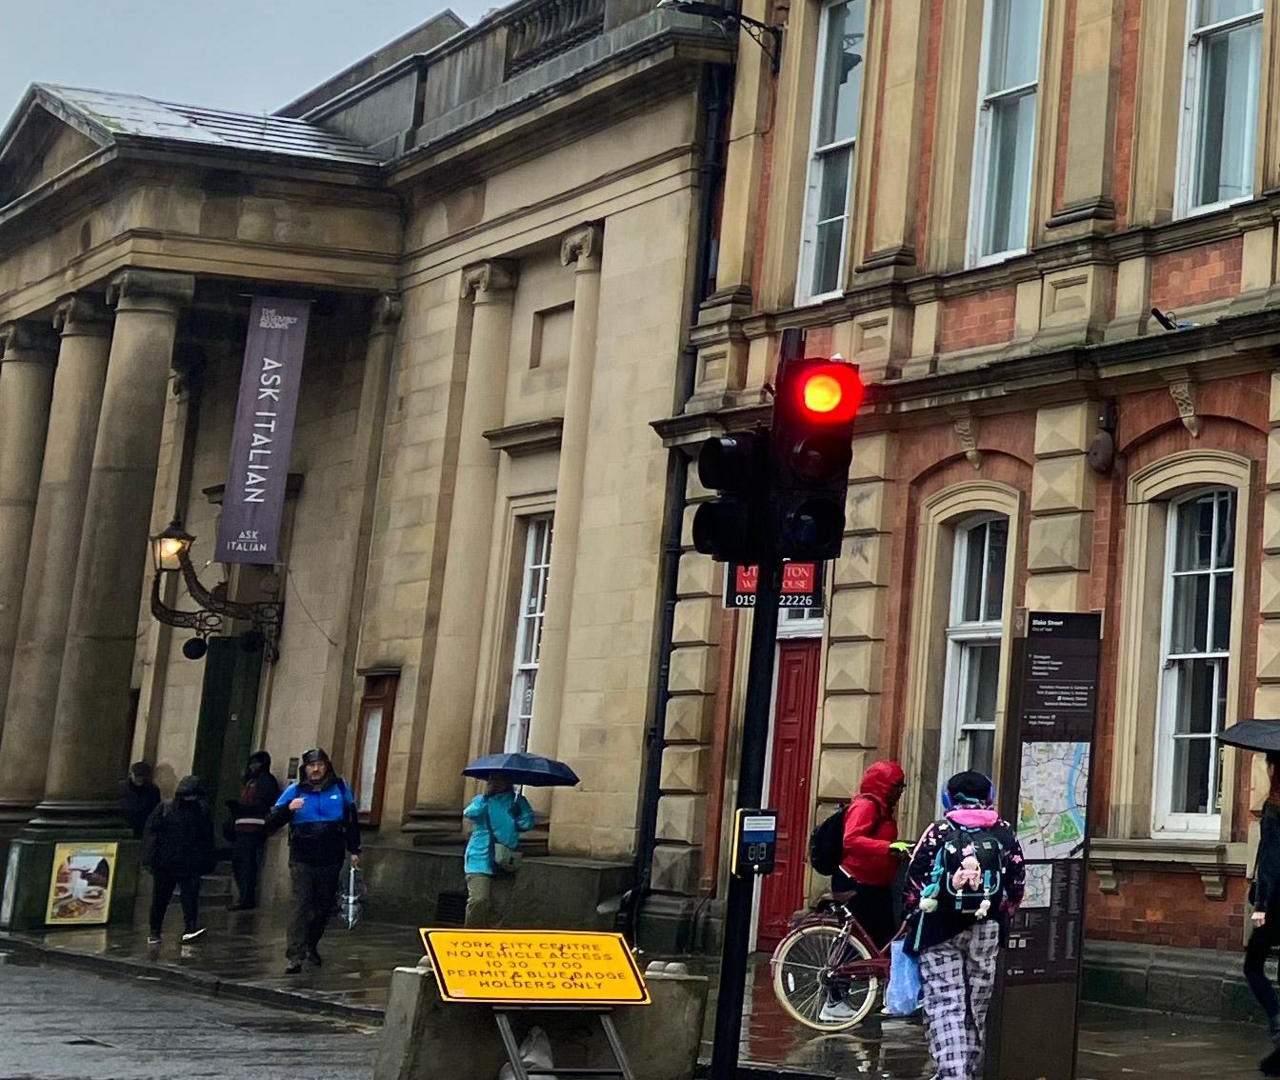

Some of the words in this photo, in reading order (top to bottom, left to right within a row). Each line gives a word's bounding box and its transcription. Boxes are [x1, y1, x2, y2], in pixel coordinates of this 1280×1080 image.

[257, 357, 283, 402] ASK
[243, 411, 277, 503] ITALIAN
[238, 530, 259, 540] ASK
[226, 541, 267, 552] ITALIAN
[450, 940, 495, 949] YORK
[499, 941, 533, 950] CITY
[539, 942, 601, 952] CENTRE
[446, 950, 472, 959] NO
[475, 951, 544, 960] VEHICLE
[549, 952, 613, 961] ACCESS
[447, 970, 505, 978] PERMIT
[528, 971, 571, 980] BLUE
[573, 971, 627, 980] BADGE
[479, 980, 556, 989] HOLDERS
[561, 981, 603, 990] ONLY
